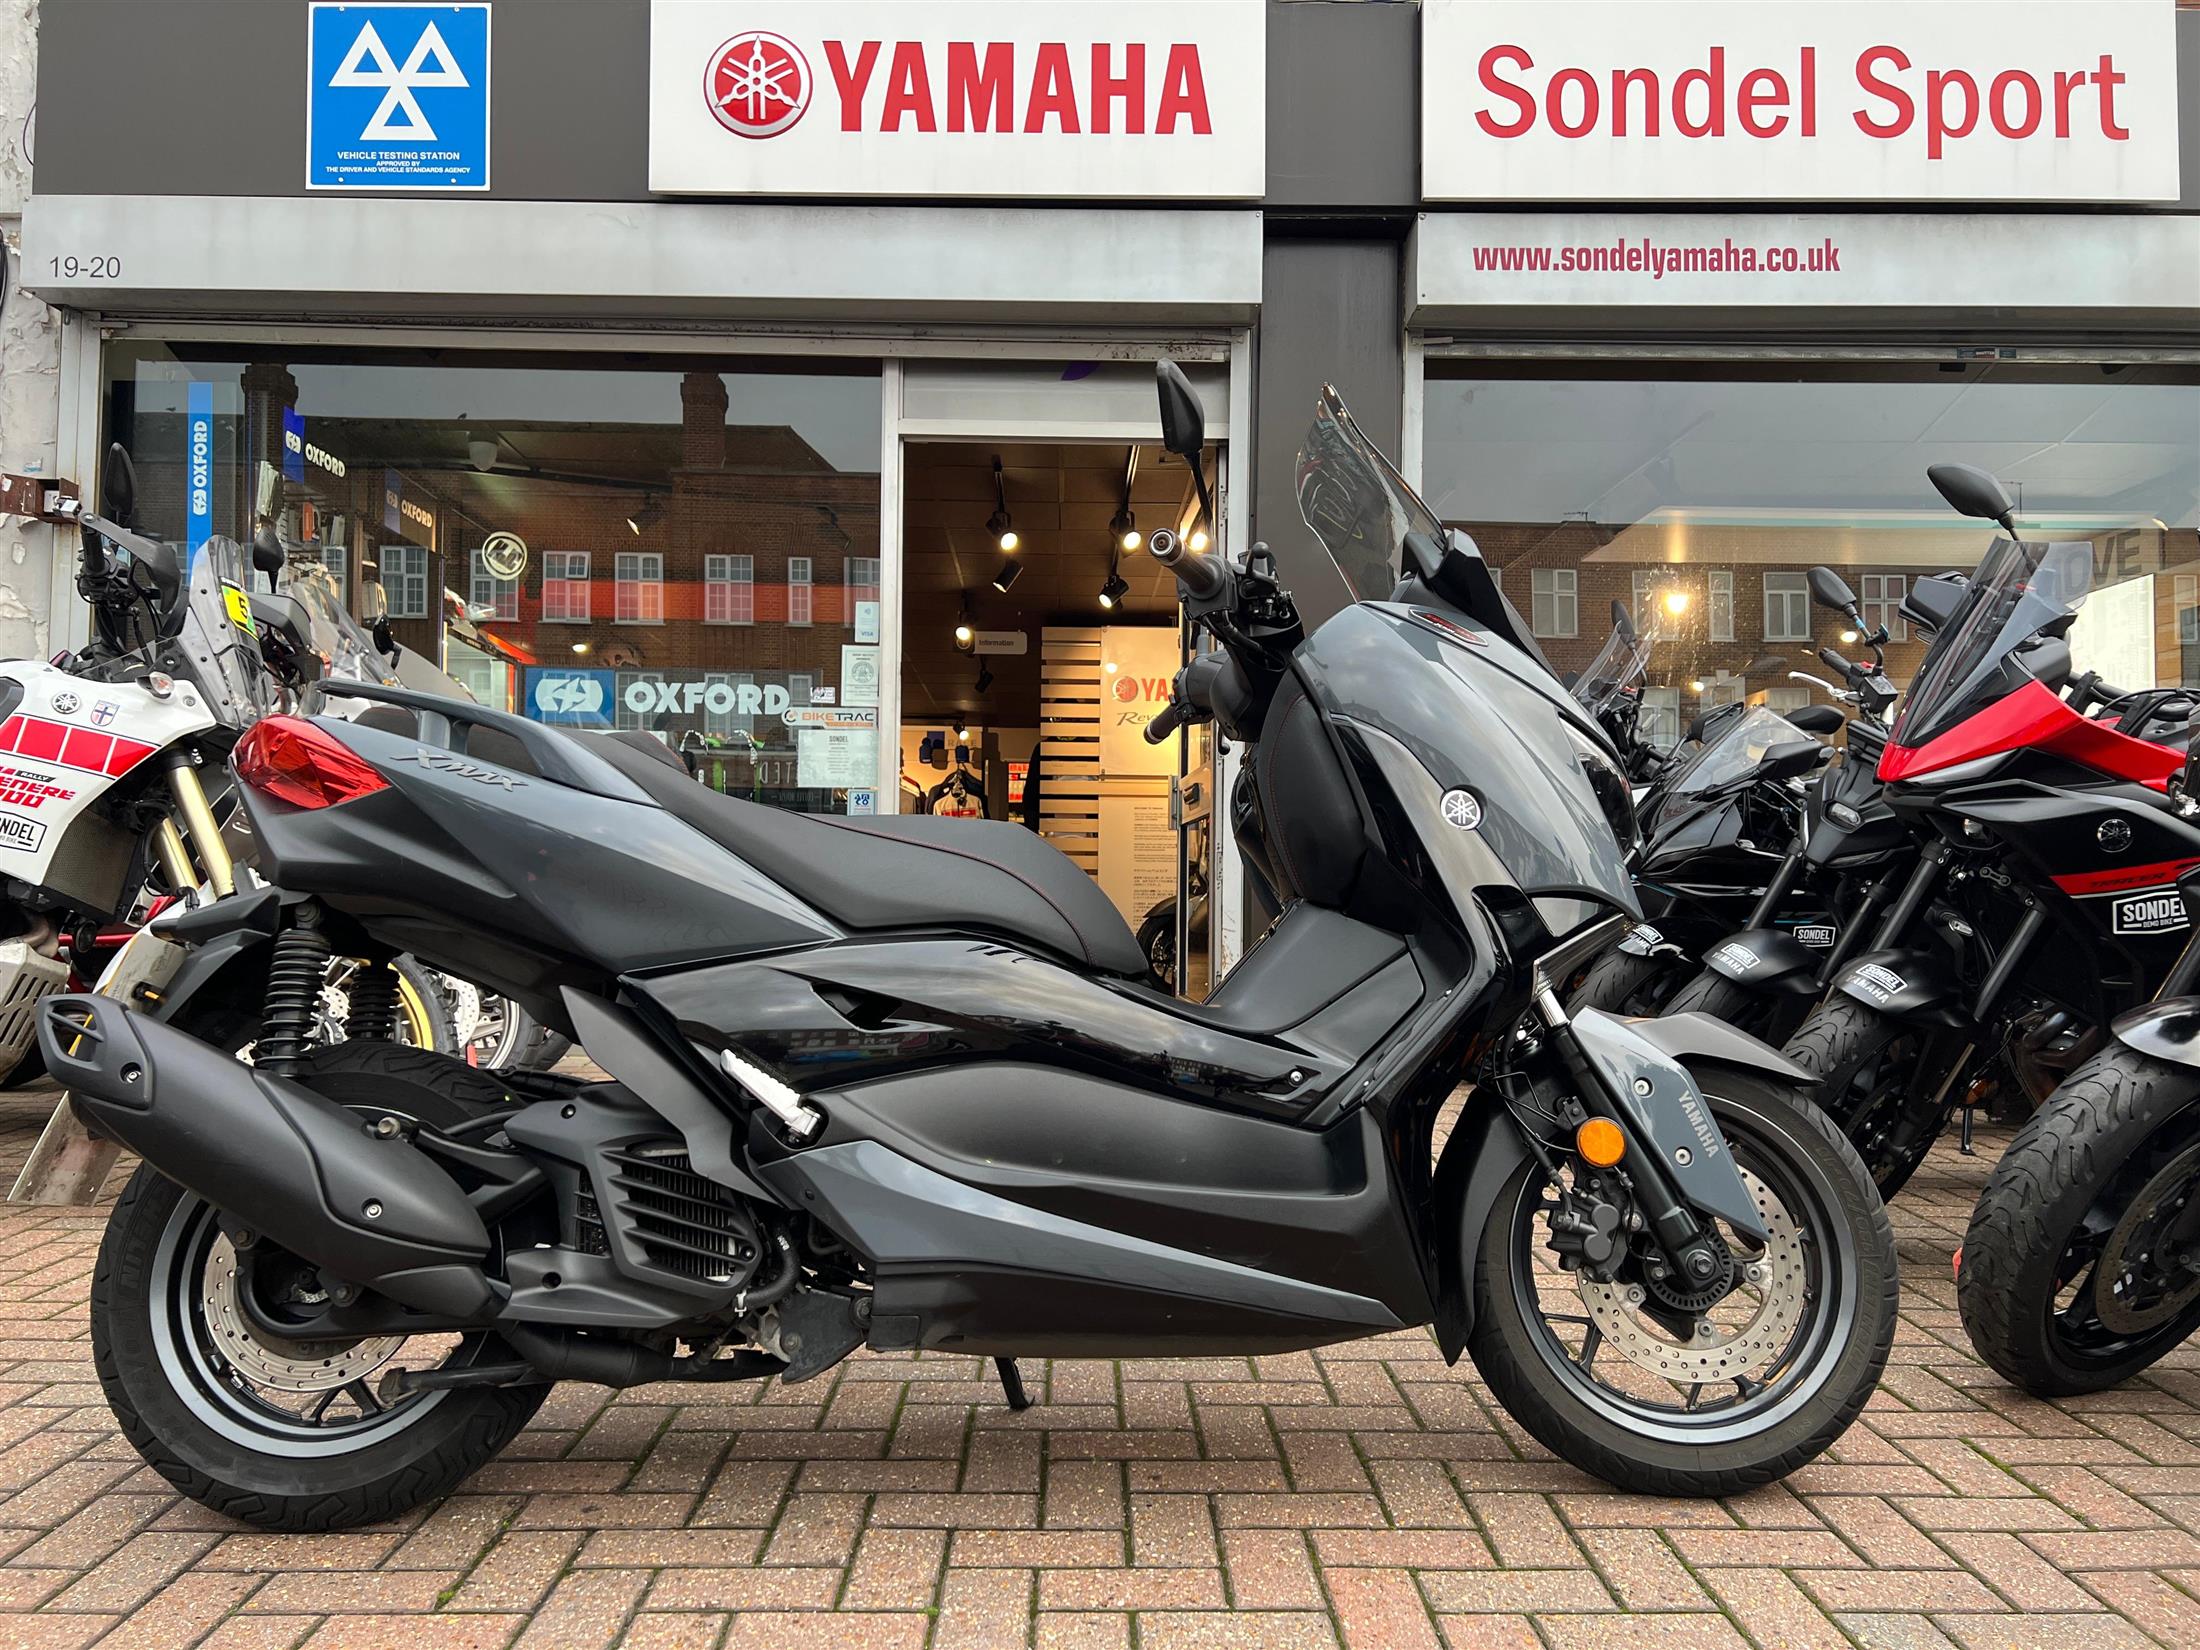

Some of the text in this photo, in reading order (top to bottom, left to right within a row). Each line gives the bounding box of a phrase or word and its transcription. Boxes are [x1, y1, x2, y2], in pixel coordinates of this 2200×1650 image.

[822, 41, 1212, 134] YAMAHA
[1474, 44, 2130, 160] Sondel Sport
[337, 151, 460, 161] VEHICLE TESTING STATION
[49, 256, 121, 279] 19-20
[1472, 238, 1840, 280] www.sondelyamaha.co.uk
[193, 420, 208, 487] OXFORD
[305, 442, 346, 478] OXFORD
[401, 499, 433, 528] OXFORD
[978, 639, 1014, 647] Information
[625, 681, 790, 716] OXFORD
[1141, 678, 1168, 702] YA
[20, 770, 49, 781] RALLY
[0, 817, 34, 842] NDEL
[1797, 929, 1830, 941] SONDEL
[1711, 951, 1745, 975] YAMAHA
[1863, 965, 1899, 987] SONDEL
[1847, 975, 1890, 1003] YAMAHA
[1678, 1089, 1719, 1158] YAMAHA
